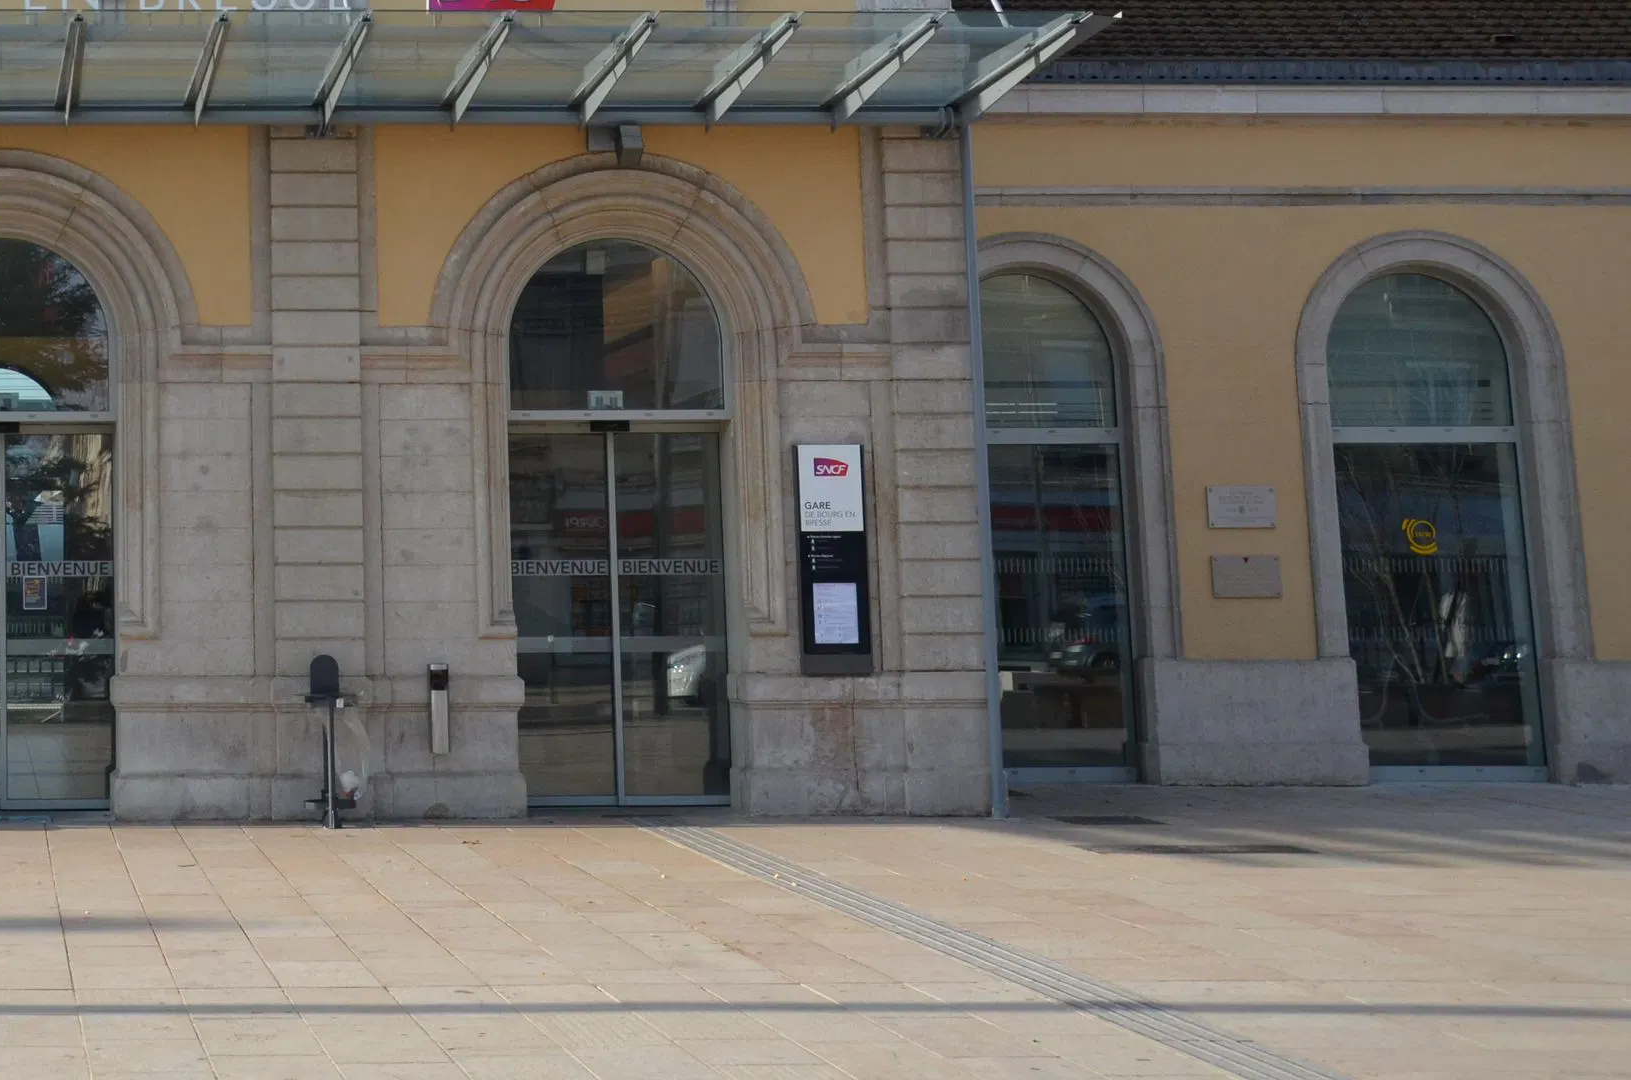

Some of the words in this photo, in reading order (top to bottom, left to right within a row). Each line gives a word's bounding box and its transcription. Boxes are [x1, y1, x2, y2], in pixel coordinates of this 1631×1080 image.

[815, 464, 847, 475] SNCF
[804, 501, 831, 510] GARE
[804, 510, 816, 519] DE
[816, 510, 843, 518] BOURG
[844, 510, 856, 518] EN
[805, 519, 832, 527] BRESSE
[11, 561, 109, 576] BIENVENUE
[511, 560, 607, 575] BIENVENUE
[622, 559, 720, 574] BIENVENUE
